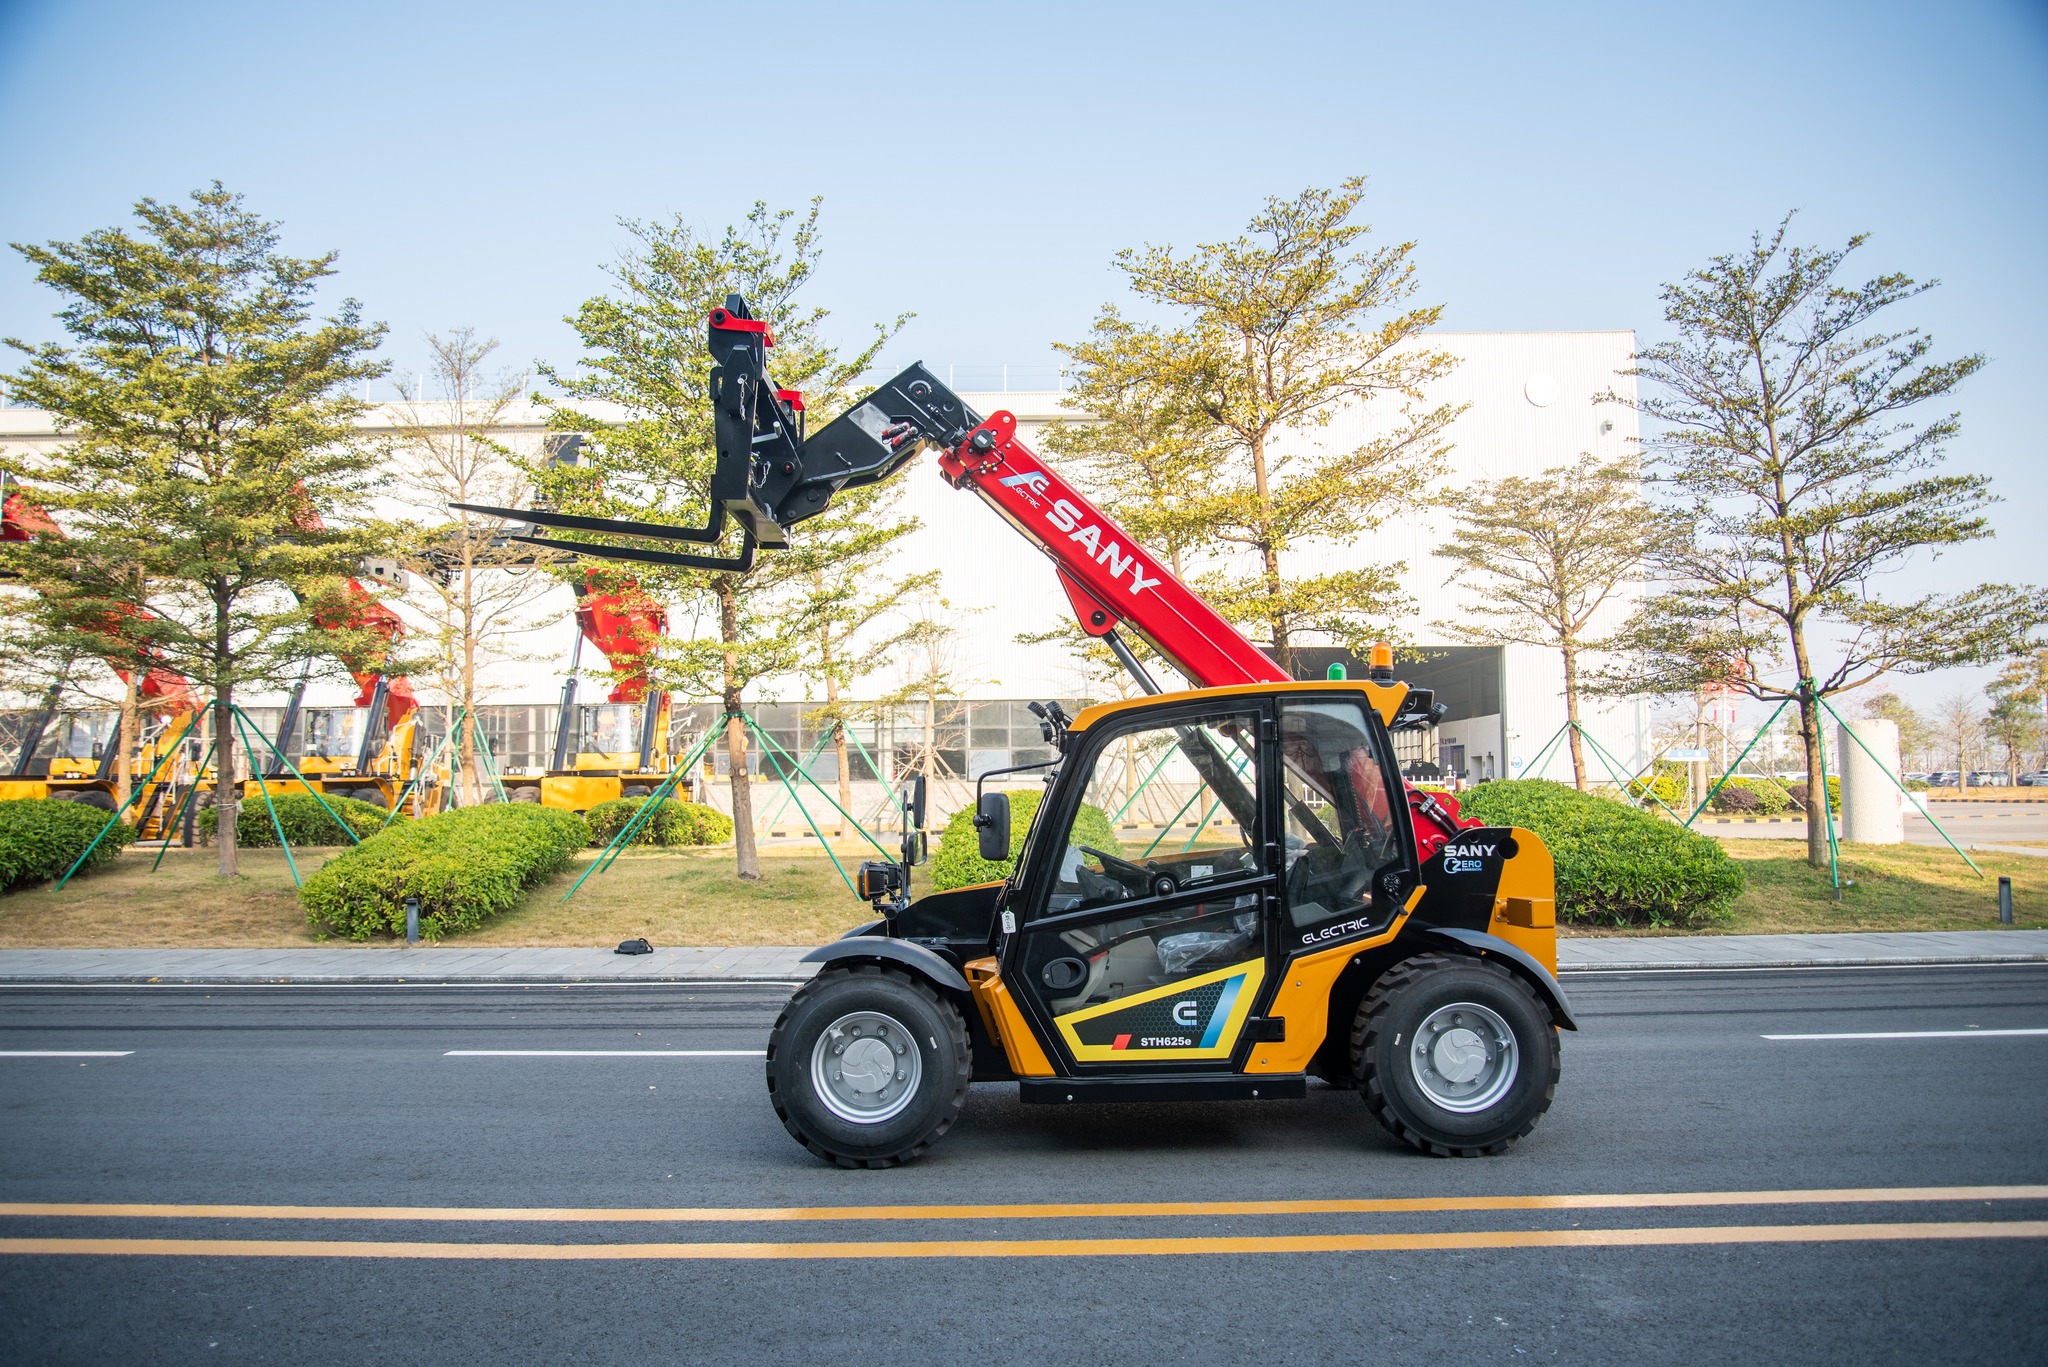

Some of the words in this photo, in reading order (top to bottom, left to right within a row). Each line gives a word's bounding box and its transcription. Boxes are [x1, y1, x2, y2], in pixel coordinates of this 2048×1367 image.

[1007, 480, 1041, 509] ELECTRIC
[1045, 498, 1162, 595] SANY
[1444, 844, 1496, 857] SANY
[1302, 916, 1369, 944] ELECTRIC
[1140, 1037, 1192, 1047] STH625e
